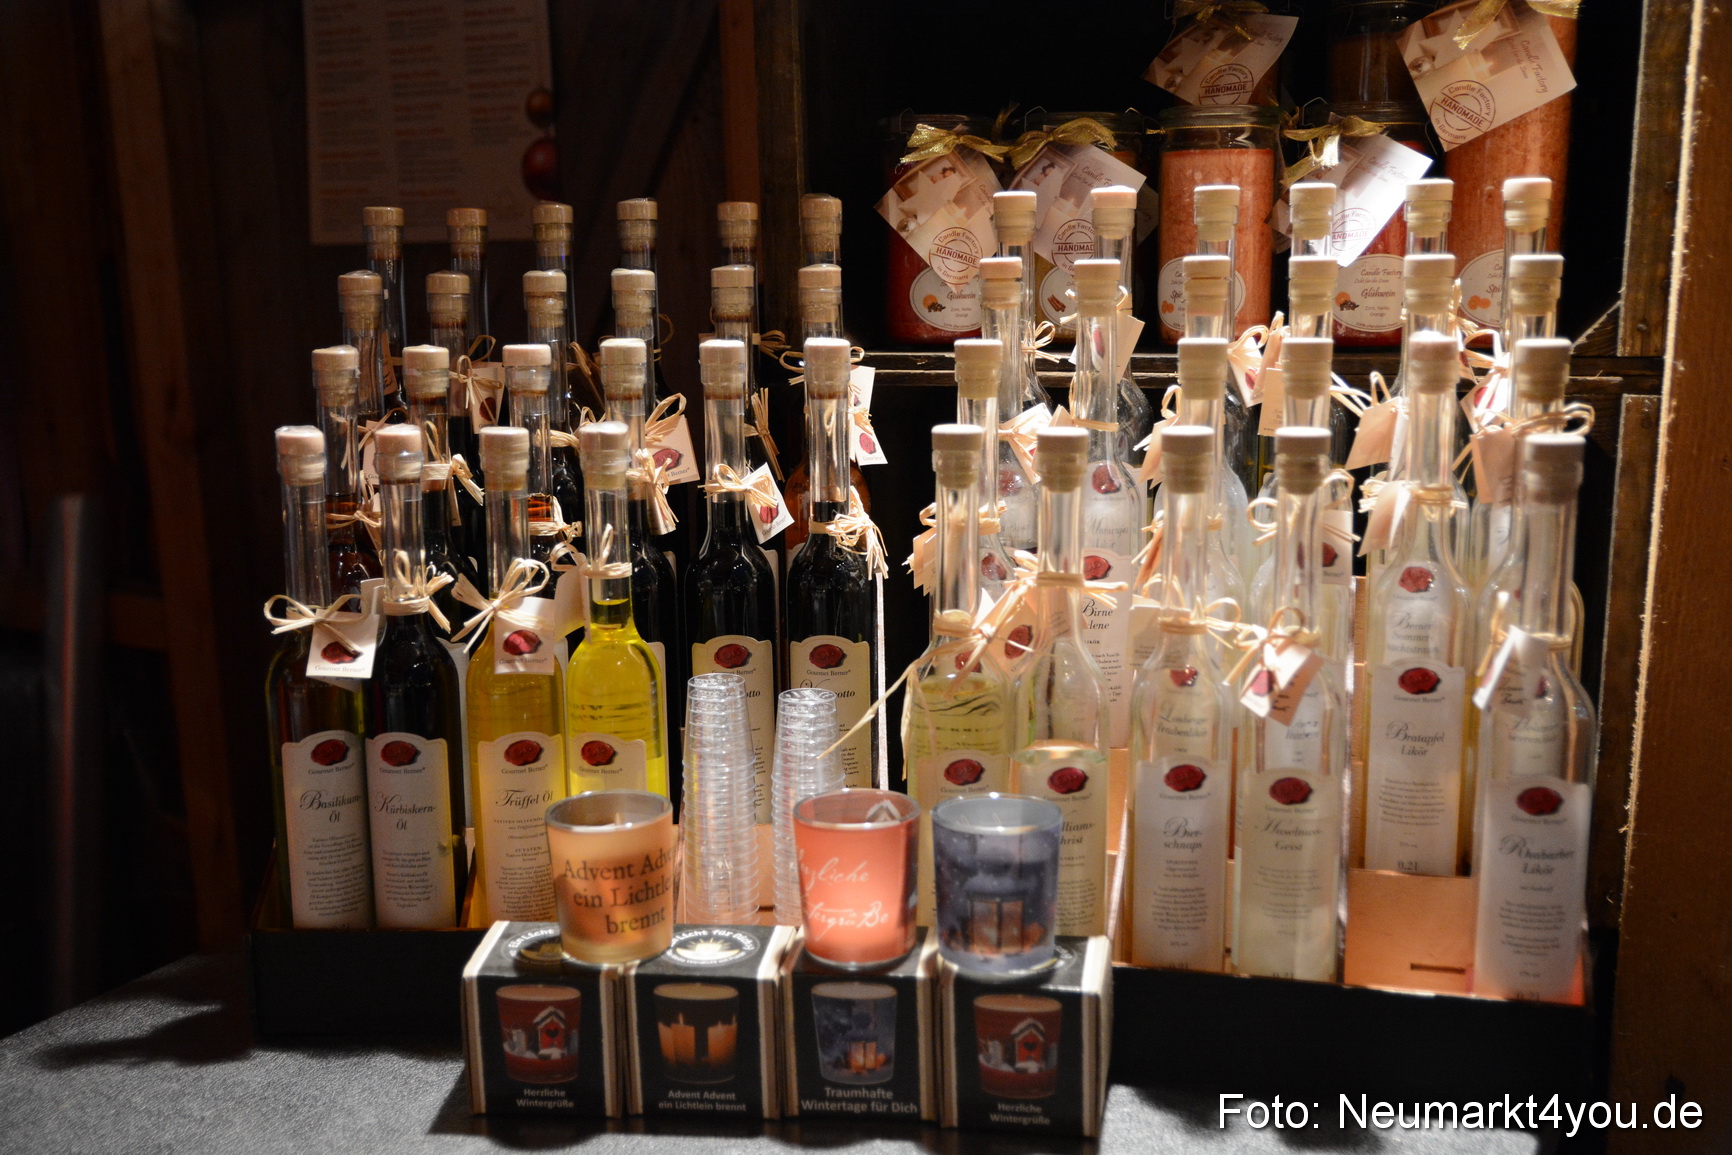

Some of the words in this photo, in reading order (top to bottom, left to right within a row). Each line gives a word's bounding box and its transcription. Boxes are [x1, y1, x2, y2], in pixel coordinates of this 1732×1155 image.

[1520, 40, 1540, 64] Candle
[1531, 63, 1550, 94] Factory
[1205, 84, 1247, 95] HANDMADE
[1448, 83, 1476, 94] Candle
[1476, 86, 1492, 116] Factory
[1441, 97, 1485, 127] HANDMADE
[1332, 230, 1369, 240] ANDMADE
[936, 247, 977, 265] HANDMADE
[1361, 268, 1380, 277] Candle
[1361, 286, 1396, 299] Glühwein
[1083, 597, 1113, 617] Birne
[1088, 620, 1110, 630] lene
[1386, 720, 1445, 746] Bratapfel
[1401, 744, 1429, 757] Likör
[299, 789, 362, 810] Basilikum-
[375, 791, 437, 814] Kürbiskern-
[496, 788, 539, 810] Trüffel
[329, 810, 341, 824] Öl
[396, 818, 408, 831] Öl
[1061, 821, 1095, 832] lliams-
[1060, 835, 1083, 845] hrist
[1163, 840, 1203, 853] schnaps
[563, 859, 634, 880] Advent
[640, 848, 672, 875] Adv
[573, 889, 603, 908] ein
[610, 876, 671, 907] Lichtle
[605, 906, 665, 935] brennt
[523, 1088, 566, 1098] Herzliche
[668, 1089, 700, 1099] Advent
[702, 1091, 736, 1101] Advent
[824, 1087, 894, 1100] Traumhafte
[516, 1098, 575, 1109] Wintergrüße
[658, 1101, 673, 1109] ein
[674, 1101, 713, 1111] Lichtlein
[715, 1102, 747, 1112] brennt
[801, 1100, 867, 1114] Wintertage
[870, 1101, 889, 1113] für
[891, 1102, 918, 1114] Dich
[997, 1103, 1042, 1113] Herzliche
[989, 1113, 1051, 1125] Wintergrüße
